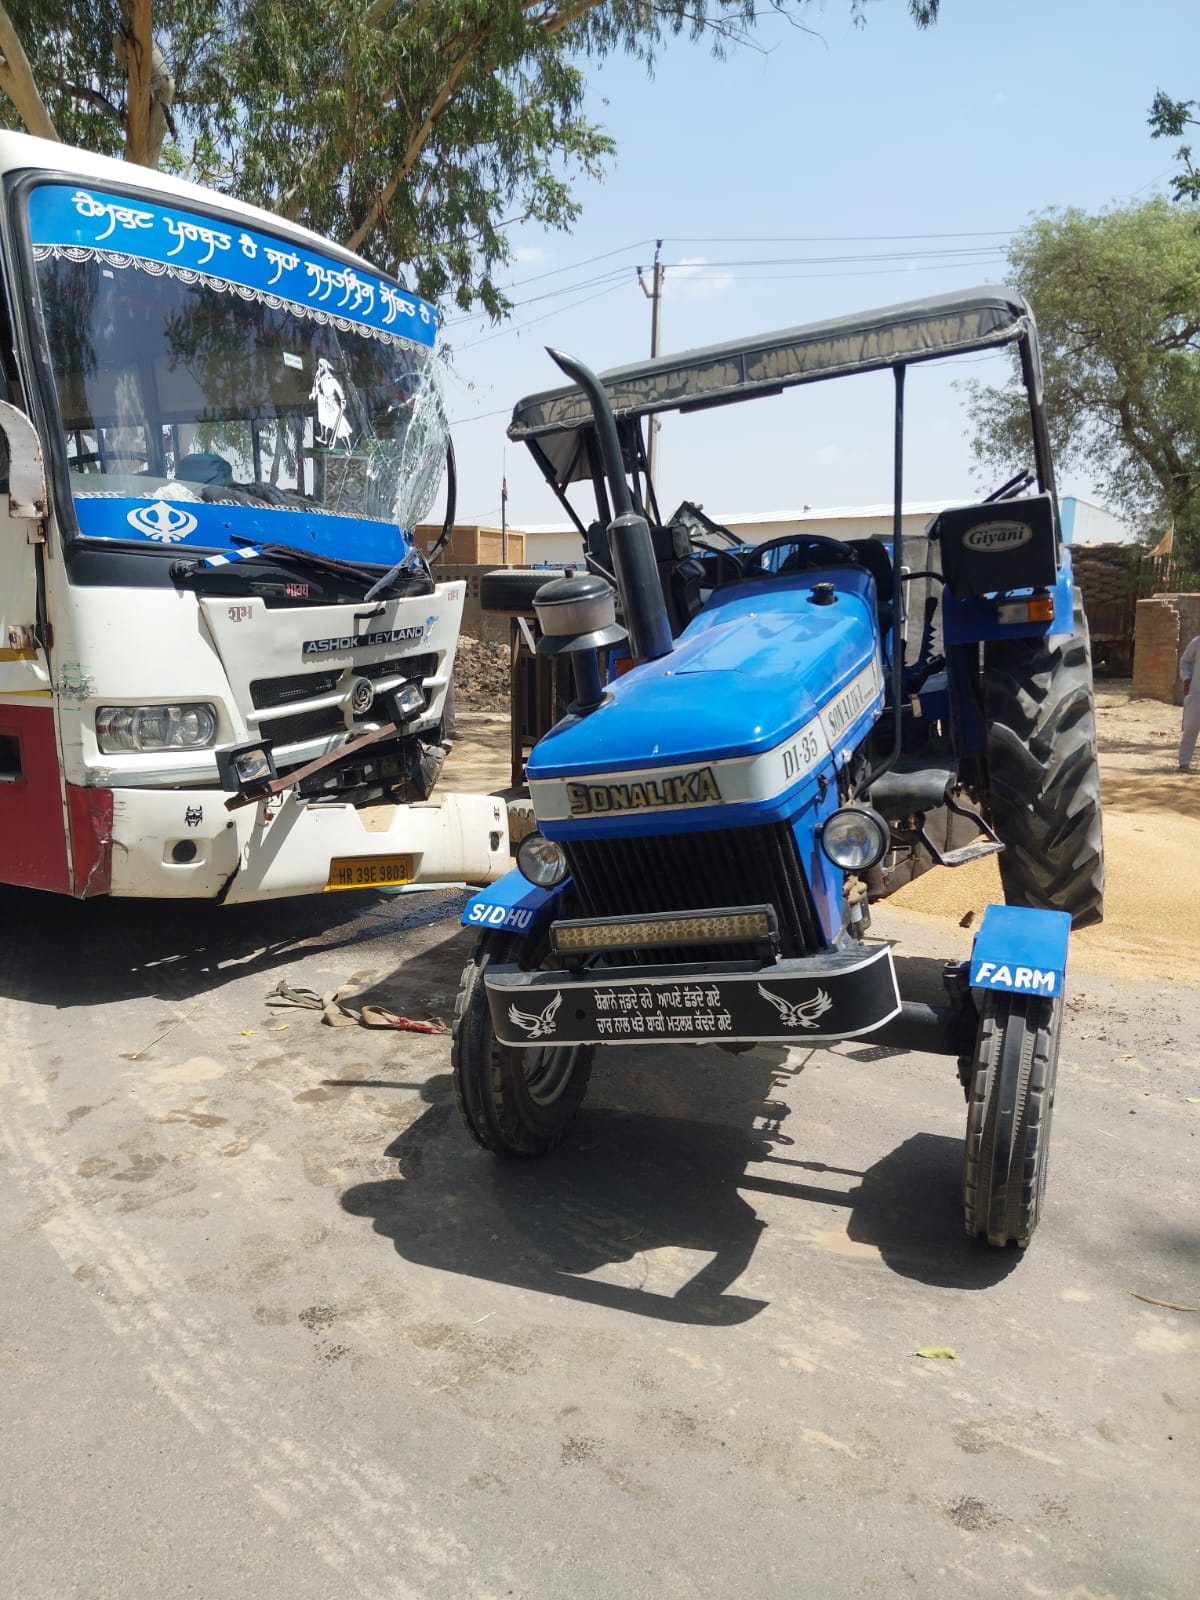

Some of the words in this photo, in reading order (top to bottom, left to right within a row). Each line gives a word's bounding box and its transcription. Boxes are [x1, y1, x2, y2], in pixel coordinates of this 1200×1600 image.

[238, 233, 257, 258] ਹੈ
[968, 526, 1025, 546] Giyani
[228, 605, 253, 623] शुभ
[306, 634, 359, 654] ASHOK
[367, 626, 424, 646] LEYLAND
[782, 730, 818, 780] DI-35
[566, 766, 722, 815] SONALIKA
[339, 867, 353, 884] HR
[357, 865, 377, 882] 39E
[468, 903, 533, 929] SIDHU
[975, 962, 1055, 992] FARM
